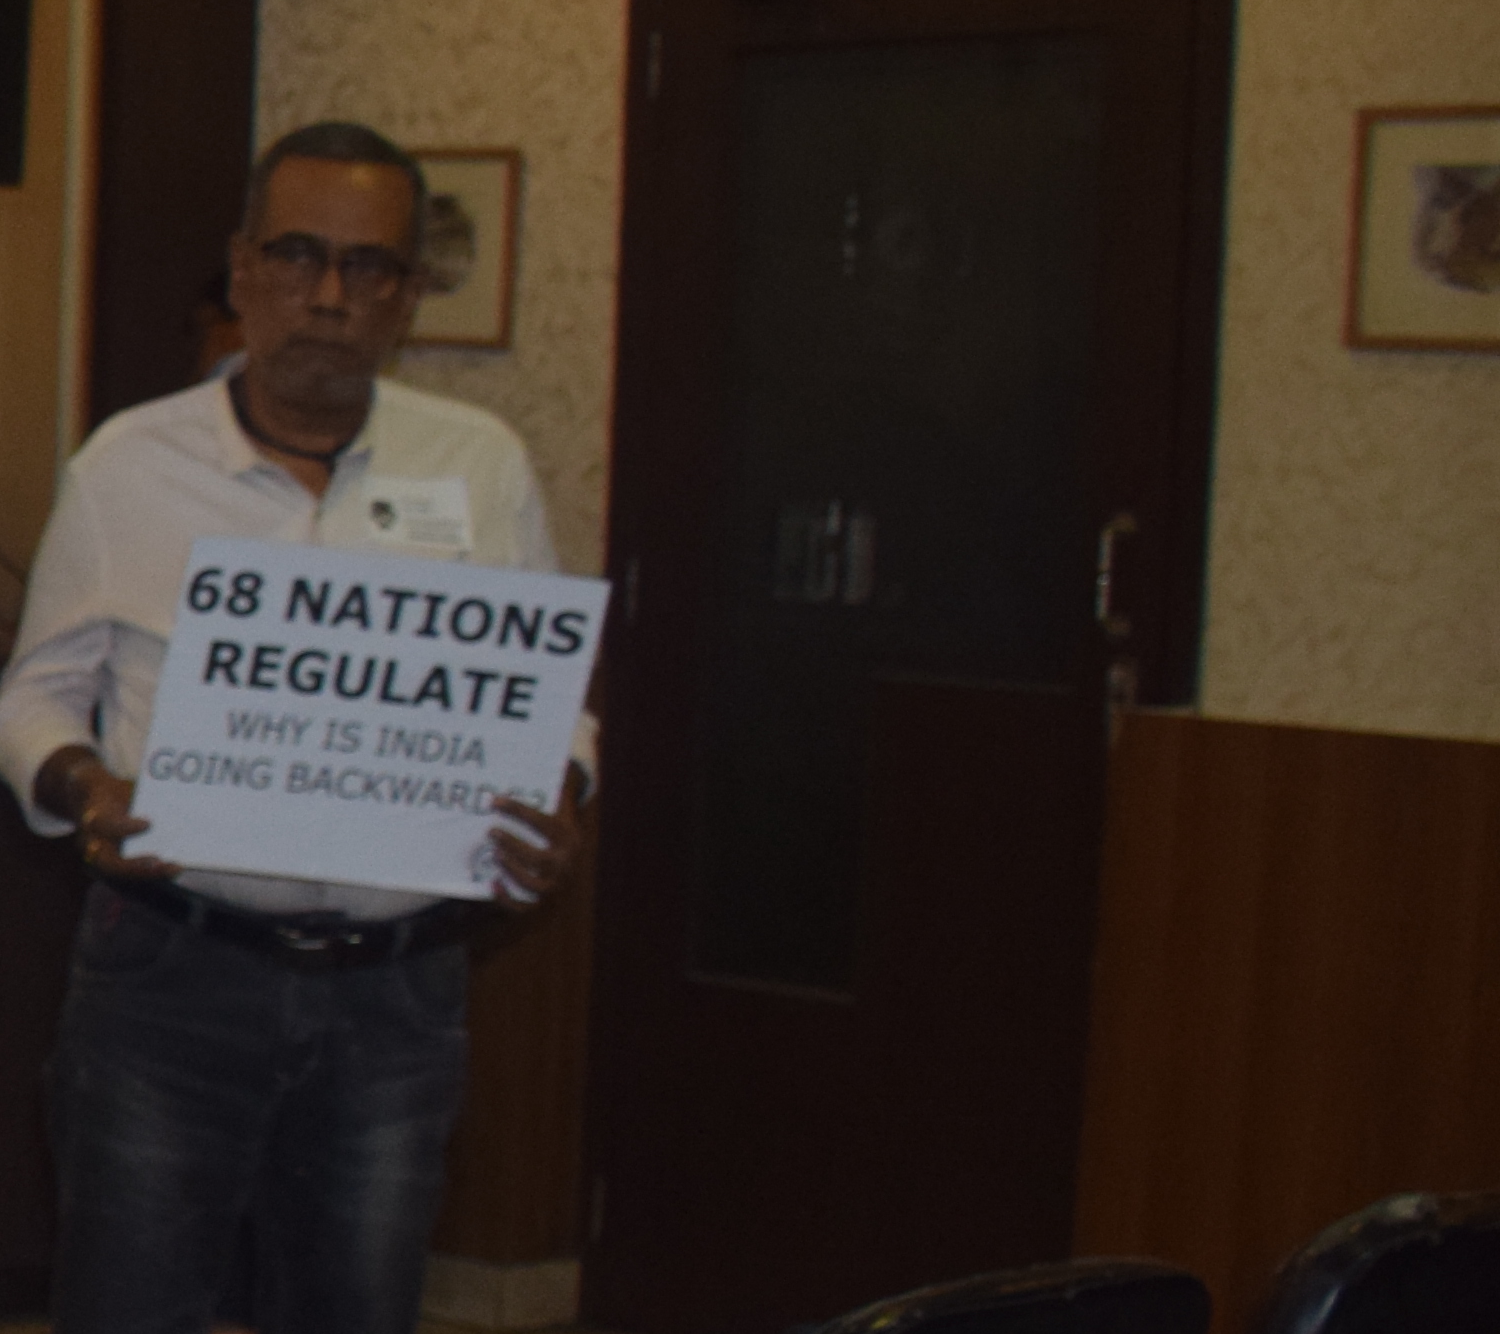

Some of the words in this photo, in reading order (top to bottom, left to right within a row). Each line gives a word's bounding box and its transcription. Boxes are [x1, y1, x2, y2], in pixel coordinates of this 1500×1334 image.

[187, 567, 263, 618] 68
[285, 578, 588, 658] NATIONS
[202, 640, 539, 723] REGULATE
[147, 746, 274, 791] GOING
[227, 709, 314, 745] WHY
[322, 717, 362, 754] IS
[374, 723, 487, 769] INDIA
